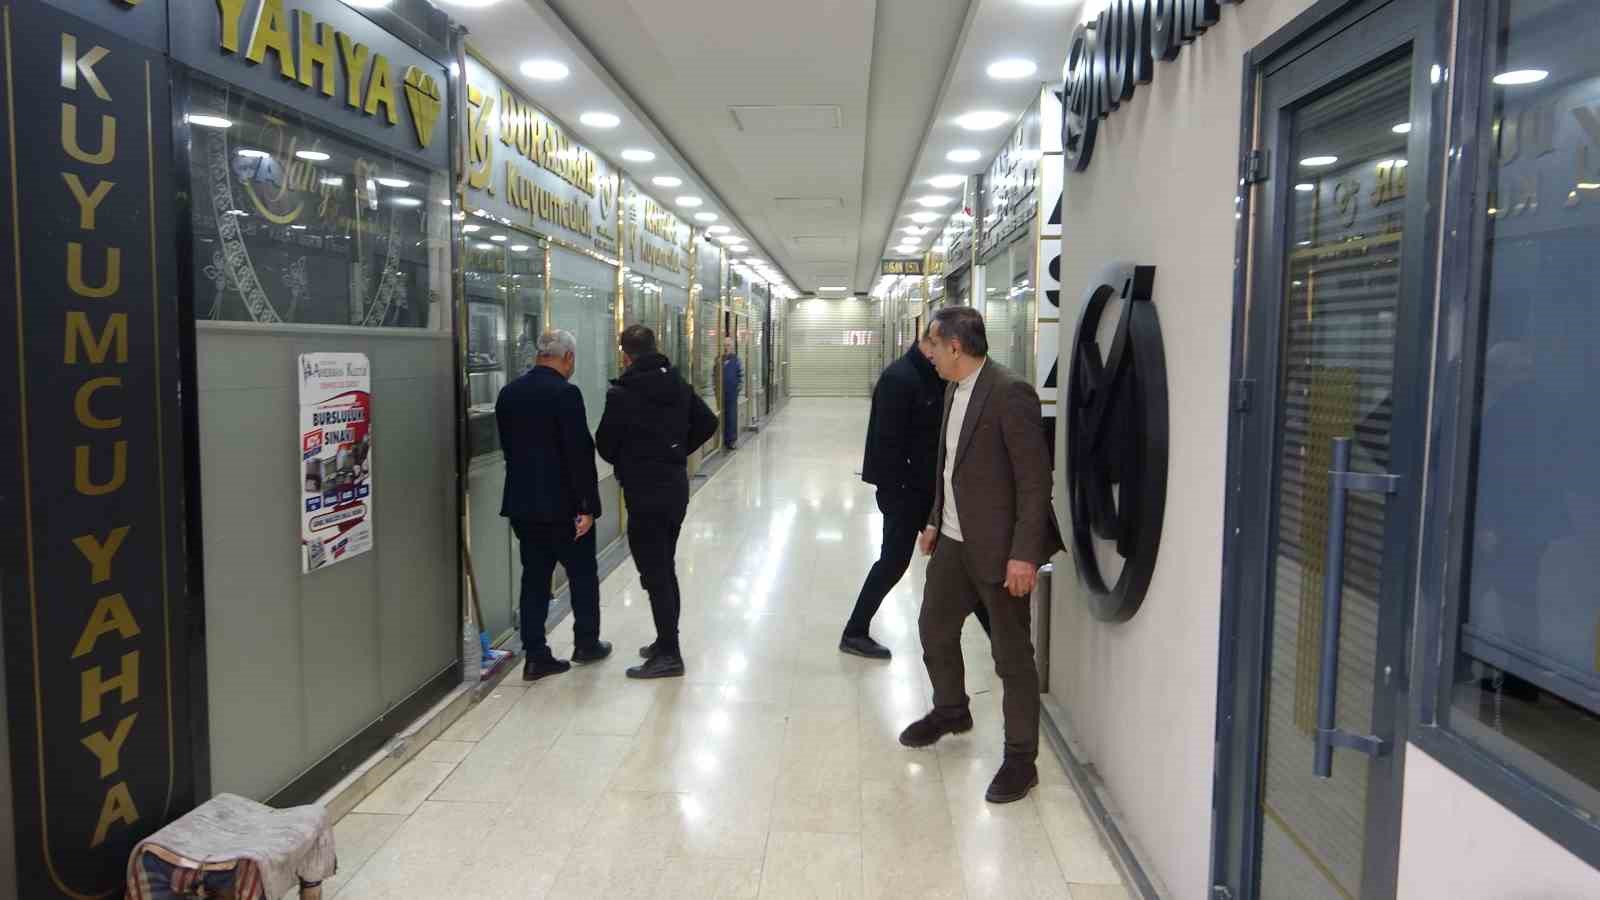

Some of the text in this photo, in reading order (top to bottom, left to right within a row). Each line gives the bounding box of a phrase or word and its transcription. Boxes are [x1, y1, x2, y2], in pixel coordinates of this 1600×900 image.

[218, 0, 398, 126] YAHYA
[60, 32, 141, 849] KUYUMCU YAHYA
